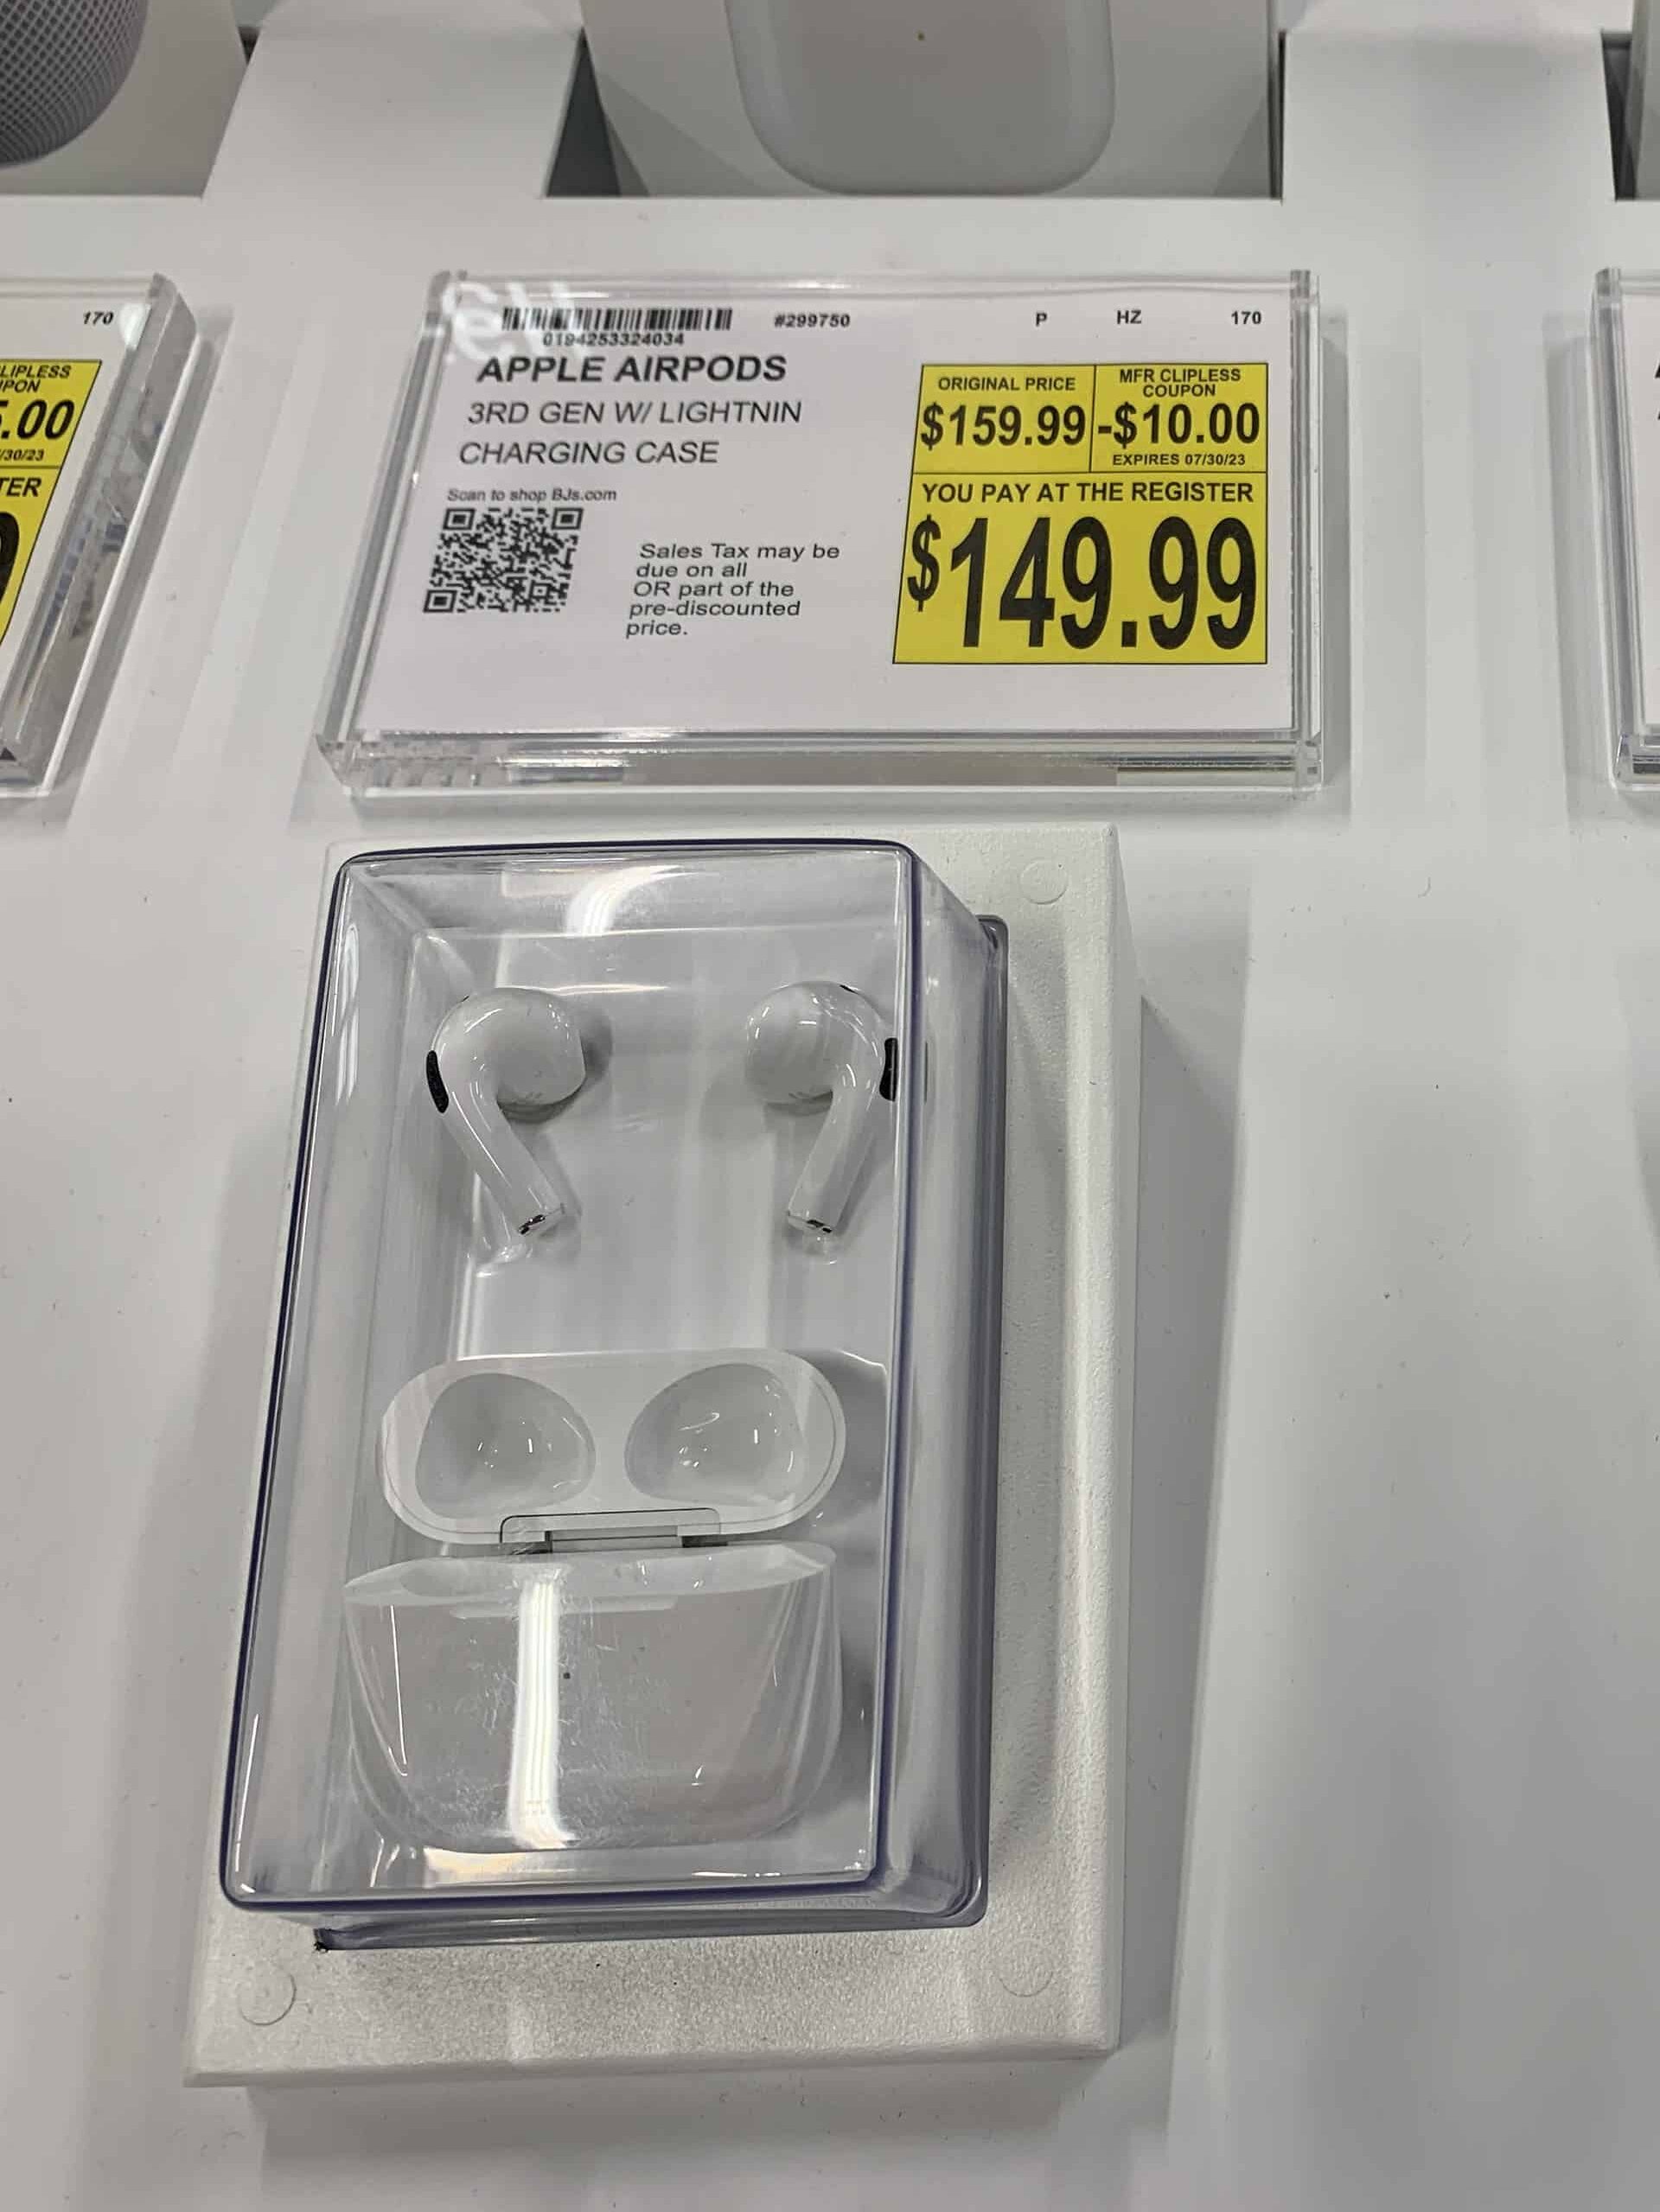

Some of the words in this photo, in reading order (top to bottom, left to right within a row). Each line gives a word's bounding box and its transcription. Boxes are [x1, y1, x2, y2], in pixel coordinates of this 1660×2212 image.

[83, 311, 113, 325] 170
[774, 313, 851, 328] #299750
[1036, 313, 1047, 326] P
[1116, 310, 1142, 324] HZ
[1230, 311, 1262, 325] 170
[0, 365, 71, 379] LIPLESS
[476, 356, 604, 382] APPLE
[614, 356, 788, 382] AIRPODS
[1120, 368, 1156, 383] MFR
[1160, 368, 1242, 383] CLIPLESS
[938, 377, 1019, 392] ORIGINAL
[1025, 377, 1076, 392] PRICE
[1142, 383, 1216, 398] COUPON
[468, 402, 529, 424] 3RD
[540, 402, 604, 424] GEN
[614, 401, 653, 424] W/
[659, 401, 802, 424] LIGHTNIN
[921, 402, 1086, 449] $159.99
[1097, 401, 1260, 449] -$10.00
[459, 443, 626, 464] CHARGING
[635, 442, 720, 463] CASE
[1113, 454, 1180, 466] EXPIRES
[1184, 453, 1246, 466] 07/30/23
[447, 488, 486, 501] Scan
[491, 488, 505, 501] to
[509, 488, 546, 503] shop
[552, 488, 616, 501] BJs.com
[922, 482, 974, 503] YOU
[980, 482, 1031, 503] PAY
[1037, 482, 1069, 502] AT
[1078, 482, 1123, 501] THE
[1131, 481, 1254, 502] REGISTER
[640, 545, 703, 559] Sales
[712, 544, 749, 559] Tax
[757, 547, 805, 564] may
[813, 544, 840, 559] be
[636, 563, 678, 578] due
[686, 566, 713, 578] on
[722, 563, 747, 578] all
[906, 514, 1257, 650] $149.99
[634, 583, 671, 597] OR
[679, 583, 723, 601] part
[731, 582, 757, 597] of
[761, 582, 795, 597] the
[629, 600, 801, 621] pre-discounted
[626, 620, 688, 639] price.
